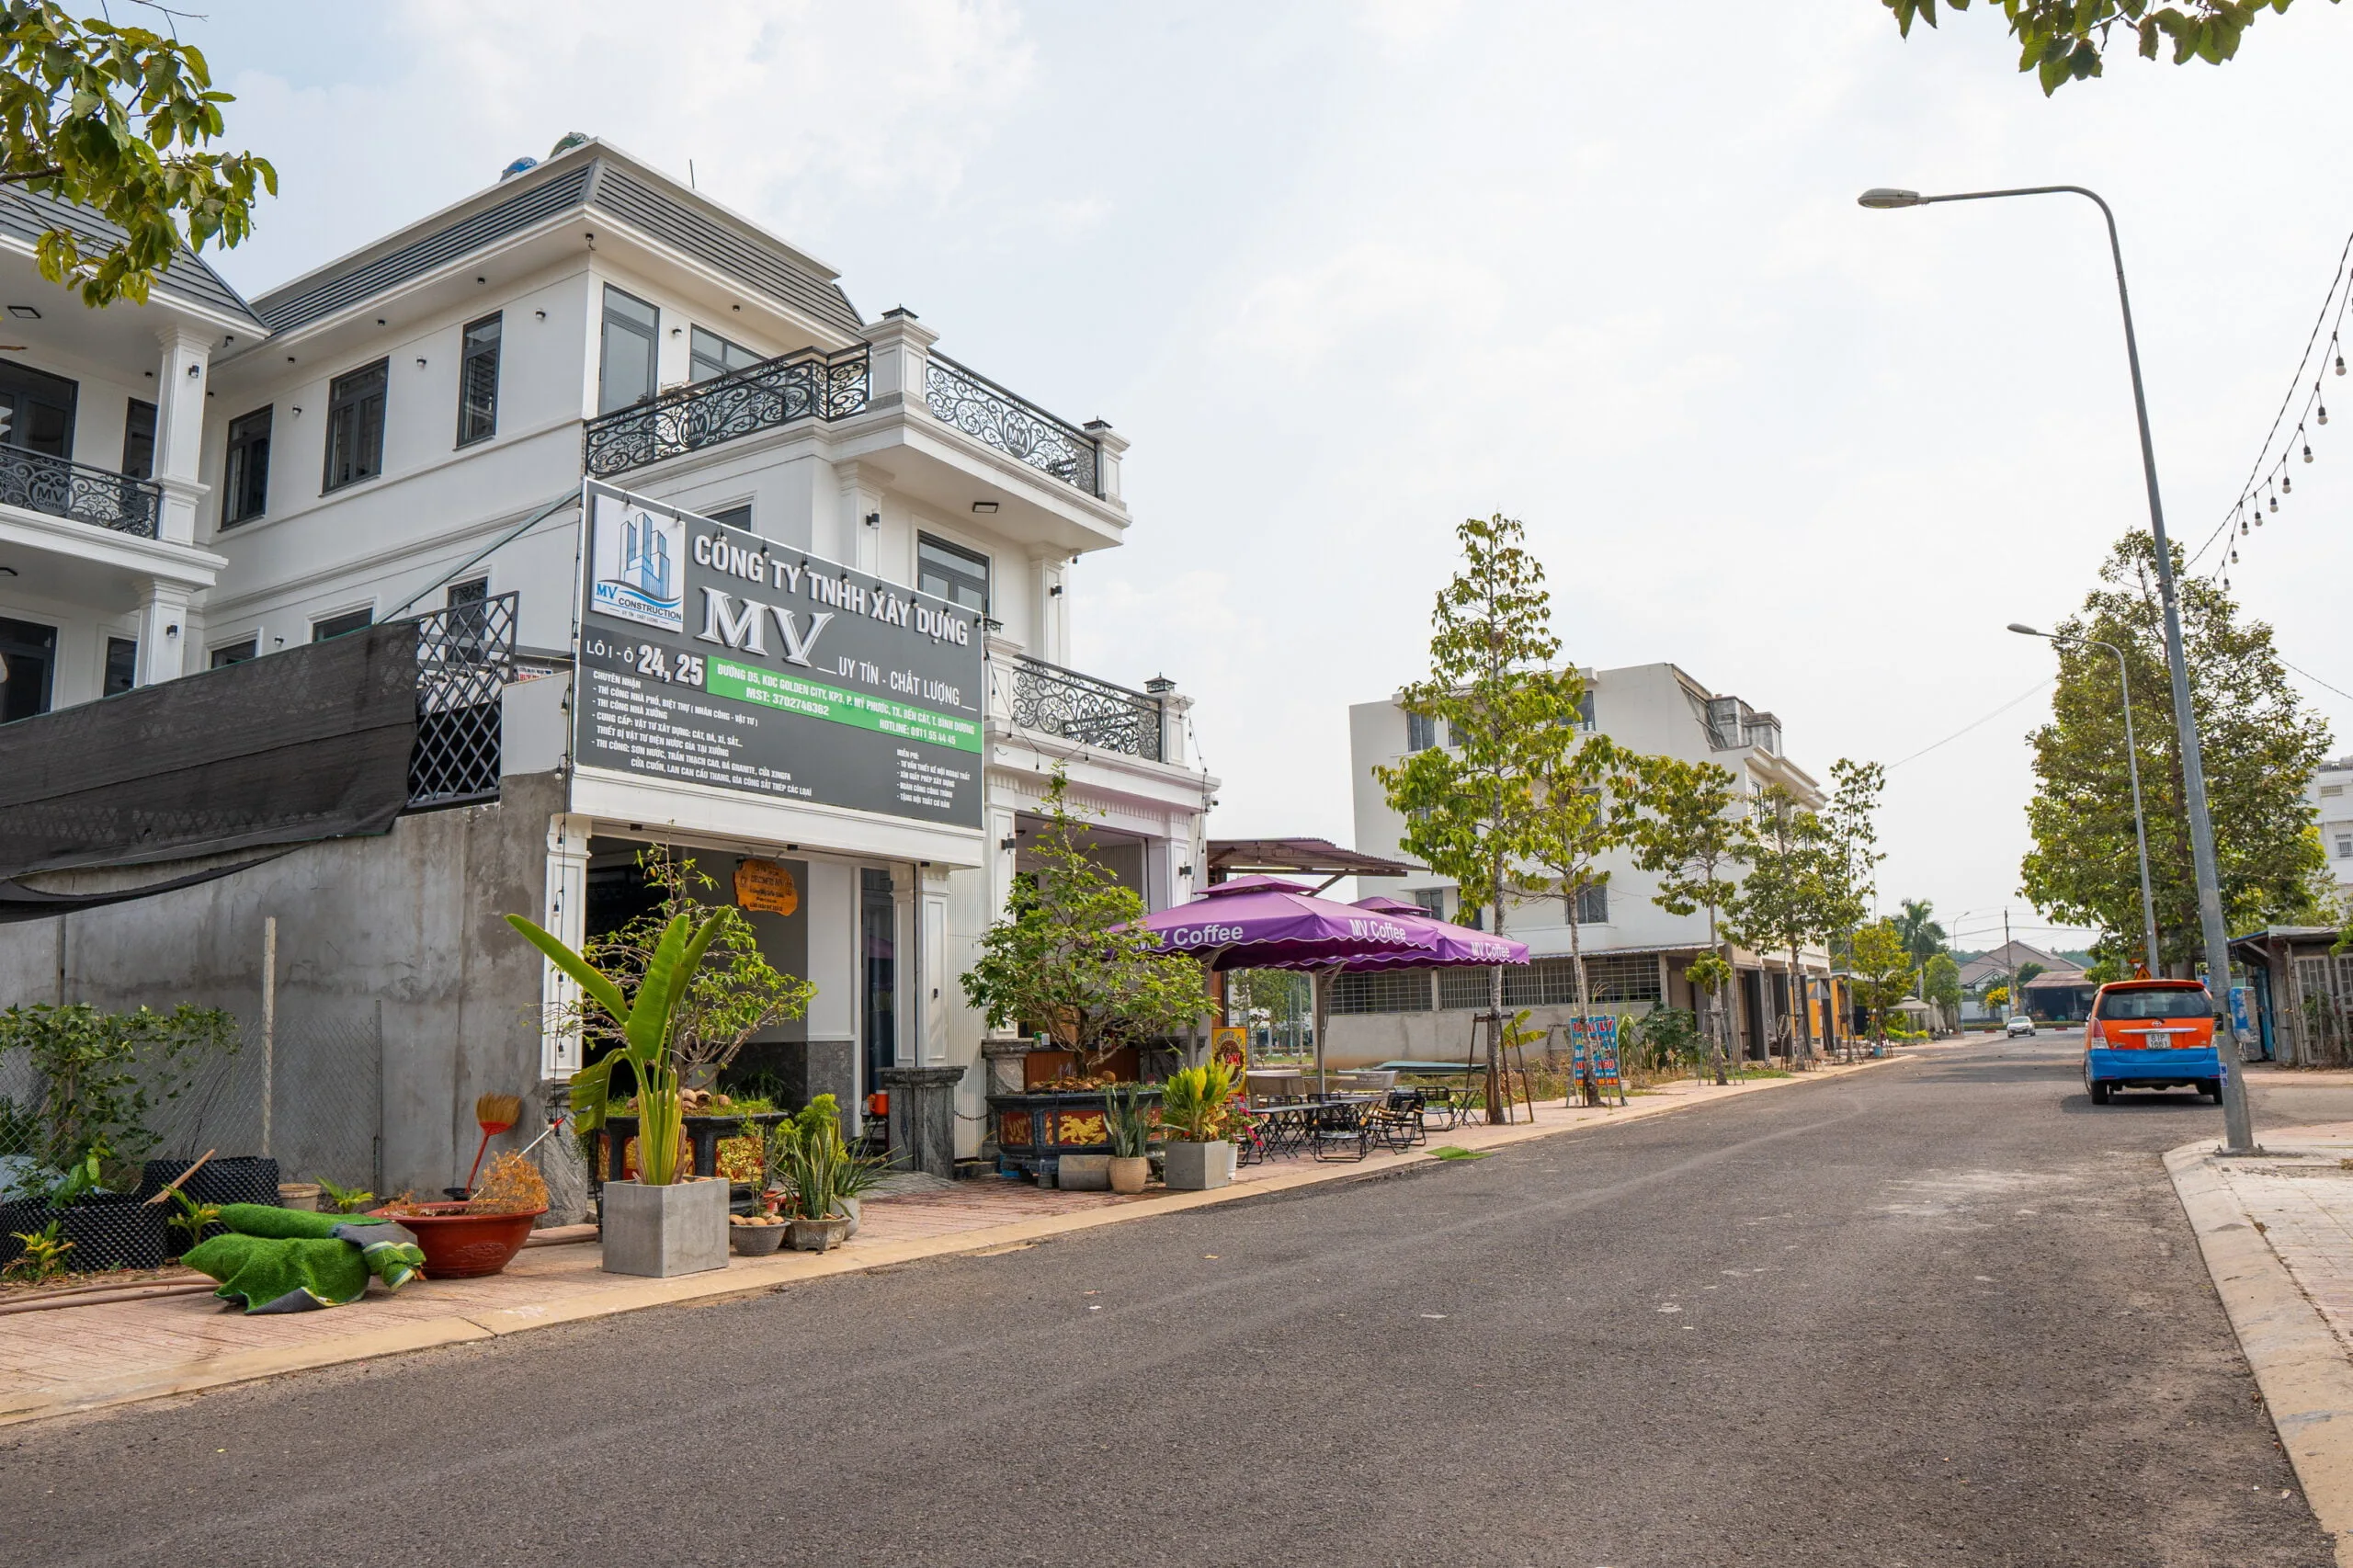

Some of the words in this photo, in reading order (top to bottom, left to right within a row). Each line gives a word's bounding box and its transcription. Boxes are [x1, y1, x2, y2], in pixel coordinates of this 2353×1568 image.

[683, 417, 703, 435] MV
[1008, 426, 1025, 444] MV
[37, 486, 65, 502] MV
[597, 583, 618, 599] MV
[693, 535, 764, 583] CÔNG
[769, 559, 801, 593] TY
[806, 571, 865, 614] TNHH
[870, 591, 911, 627] XÂY
[915, 607, 968, 645] DỰNG
[619, 597, 682, 620] CONSTRUCTION
[693, 585, 835, 667] MV
[586, 639, 606, 656] LÔ
[623, 646, 634, 663] Ô
[674, 653, 703, 686] 25
[593, 670, 620, 684] CHUYÊN
[621, 676, 642, 689] NHẬN
[717, 663, 746, 680] ĐƯỜNG
[762, 675, 779, 687] KDC
[779, 678, 809, 696] GOLDEN
[810, 687, 827, 700] CITY,
[838, 655, 856, 678] UY
[859, 661, 879, 686] TÍN
[890, 669, 920, 696] CHẤT
[924, 679, 960, 706] LƯỢNG
[610, 687, 629, 699] CÔNG
[713, 710, 730, 721] CÔNG
[746, 687, 770, 703] MST:
[597, 699, 608, 708] THI
[609, 700, 629, 712] CÔNG
[630, 704, 644, 715] NHÀ
[597, 711, 616, 723] CUNG
[634, 718, 647, 731] VẬT
[648, 722, 657, 731] TƯ
[657, 723, 671, 733] XÂY
[879, 719, 909, 735] HOTLINE:
[597, 724, 617, 737] THIẾT
[617, 728, 625, 740] BỊ
[625, 730, 639, 742] VẬT
[640, 733, 649, 743] TƯ
[649, 734, 665, 746] ĐIỆN
[697, 744, 708, 755] TẠI
[597, 739, 608, 749] THI
[631, 744, 645, 756] SƠN
[686, 754, 706, 767] THẠCH
[722, 760, 731, 770] ĐÁ
[771, 770, 791, 781] XINGFA
[631, 756, 645, 769] CỬA
[666, 764, 680, 775] LAN
[680, 767, 694, 778] CAN
[744, 777, 759, 788] CÔNG
[1173, 924, 1244, 946] Coffee
[1349, 919, 1369, 937] MV
[1370, 919, 1406, 940] Coffee
[1471, 941, 1485, 957] MV
[1486, 942, 1510, 958] Coffee
